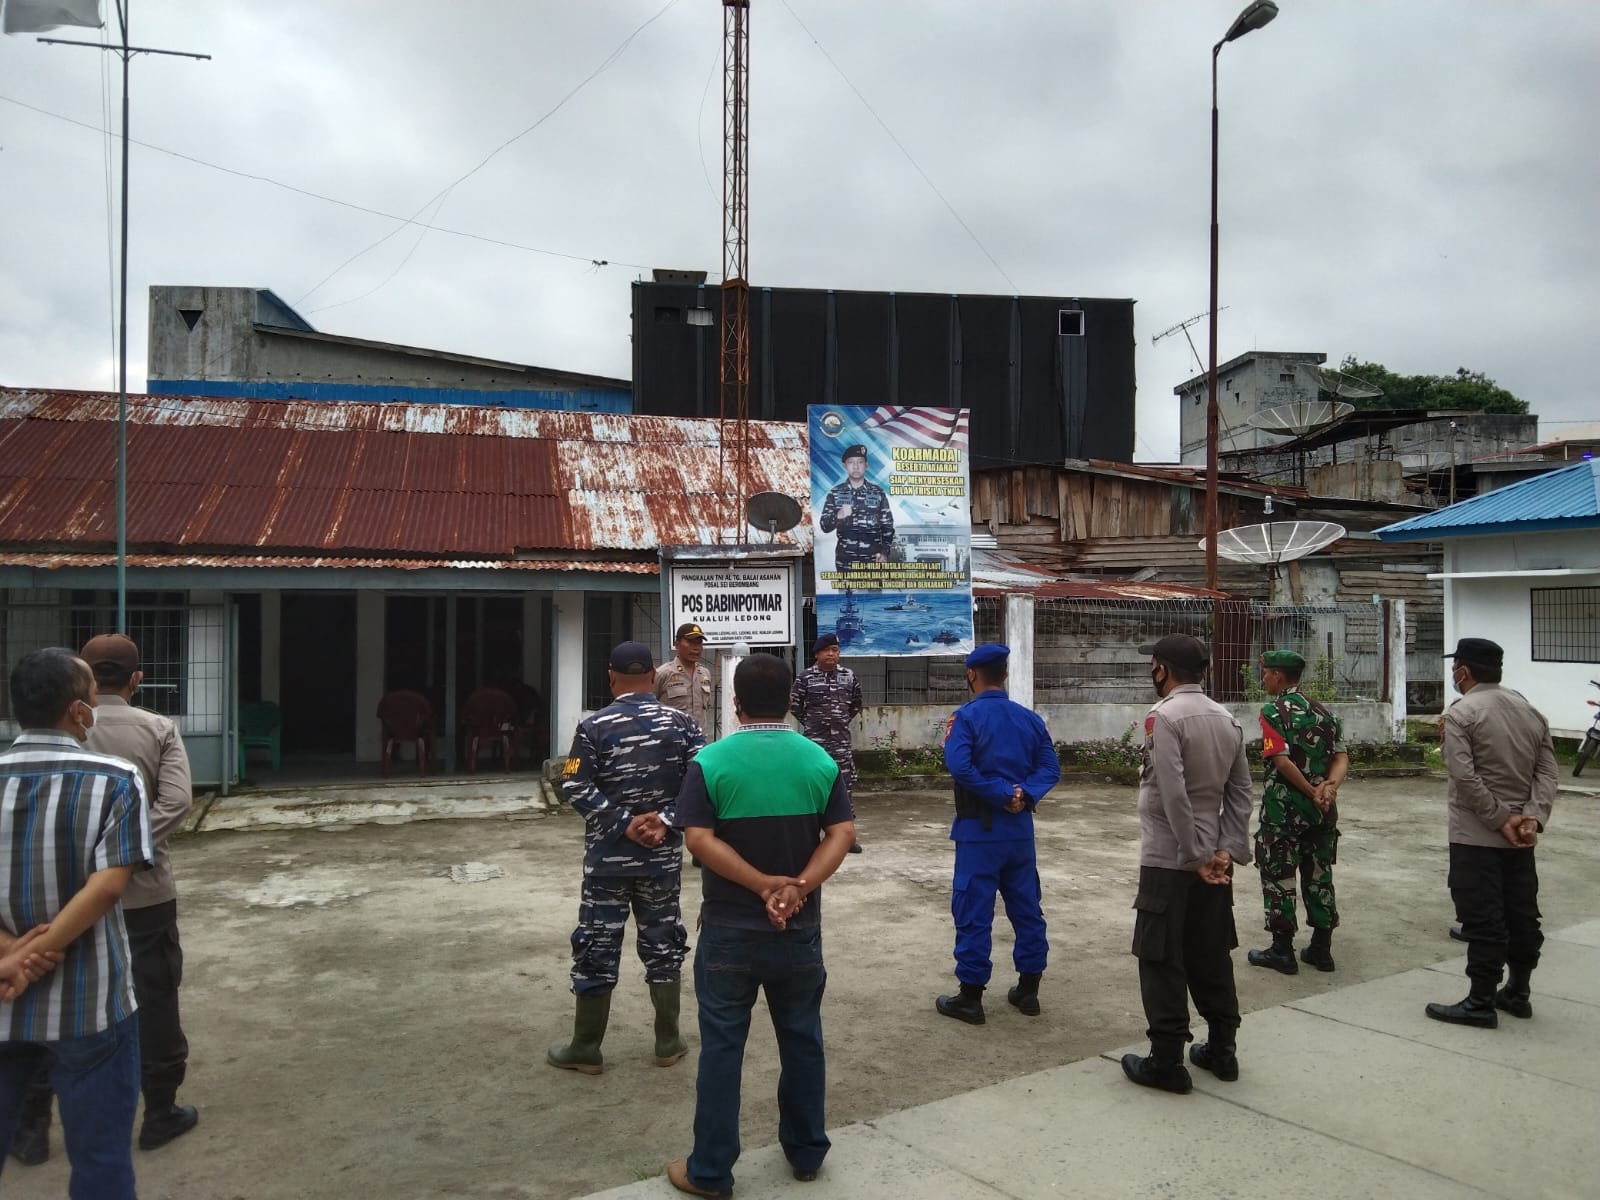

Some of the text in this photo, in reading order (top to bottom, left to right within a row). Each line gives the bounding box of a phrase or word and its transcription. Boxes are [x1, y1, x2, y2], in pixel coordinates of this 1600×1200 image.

[892, 448, 955, 462] KOARMADA
[896, 462, 926, 472] BESERTA
[889, 475, 964, 485] SIAP MENYUKSESKAN
[890, 486, 913, 495] BULAN
[914, 486, 942, 496] TRISILA
[943, 487, 956, 496] TNI
[681, 594, 782, 612] POS BABINPOTMAR
